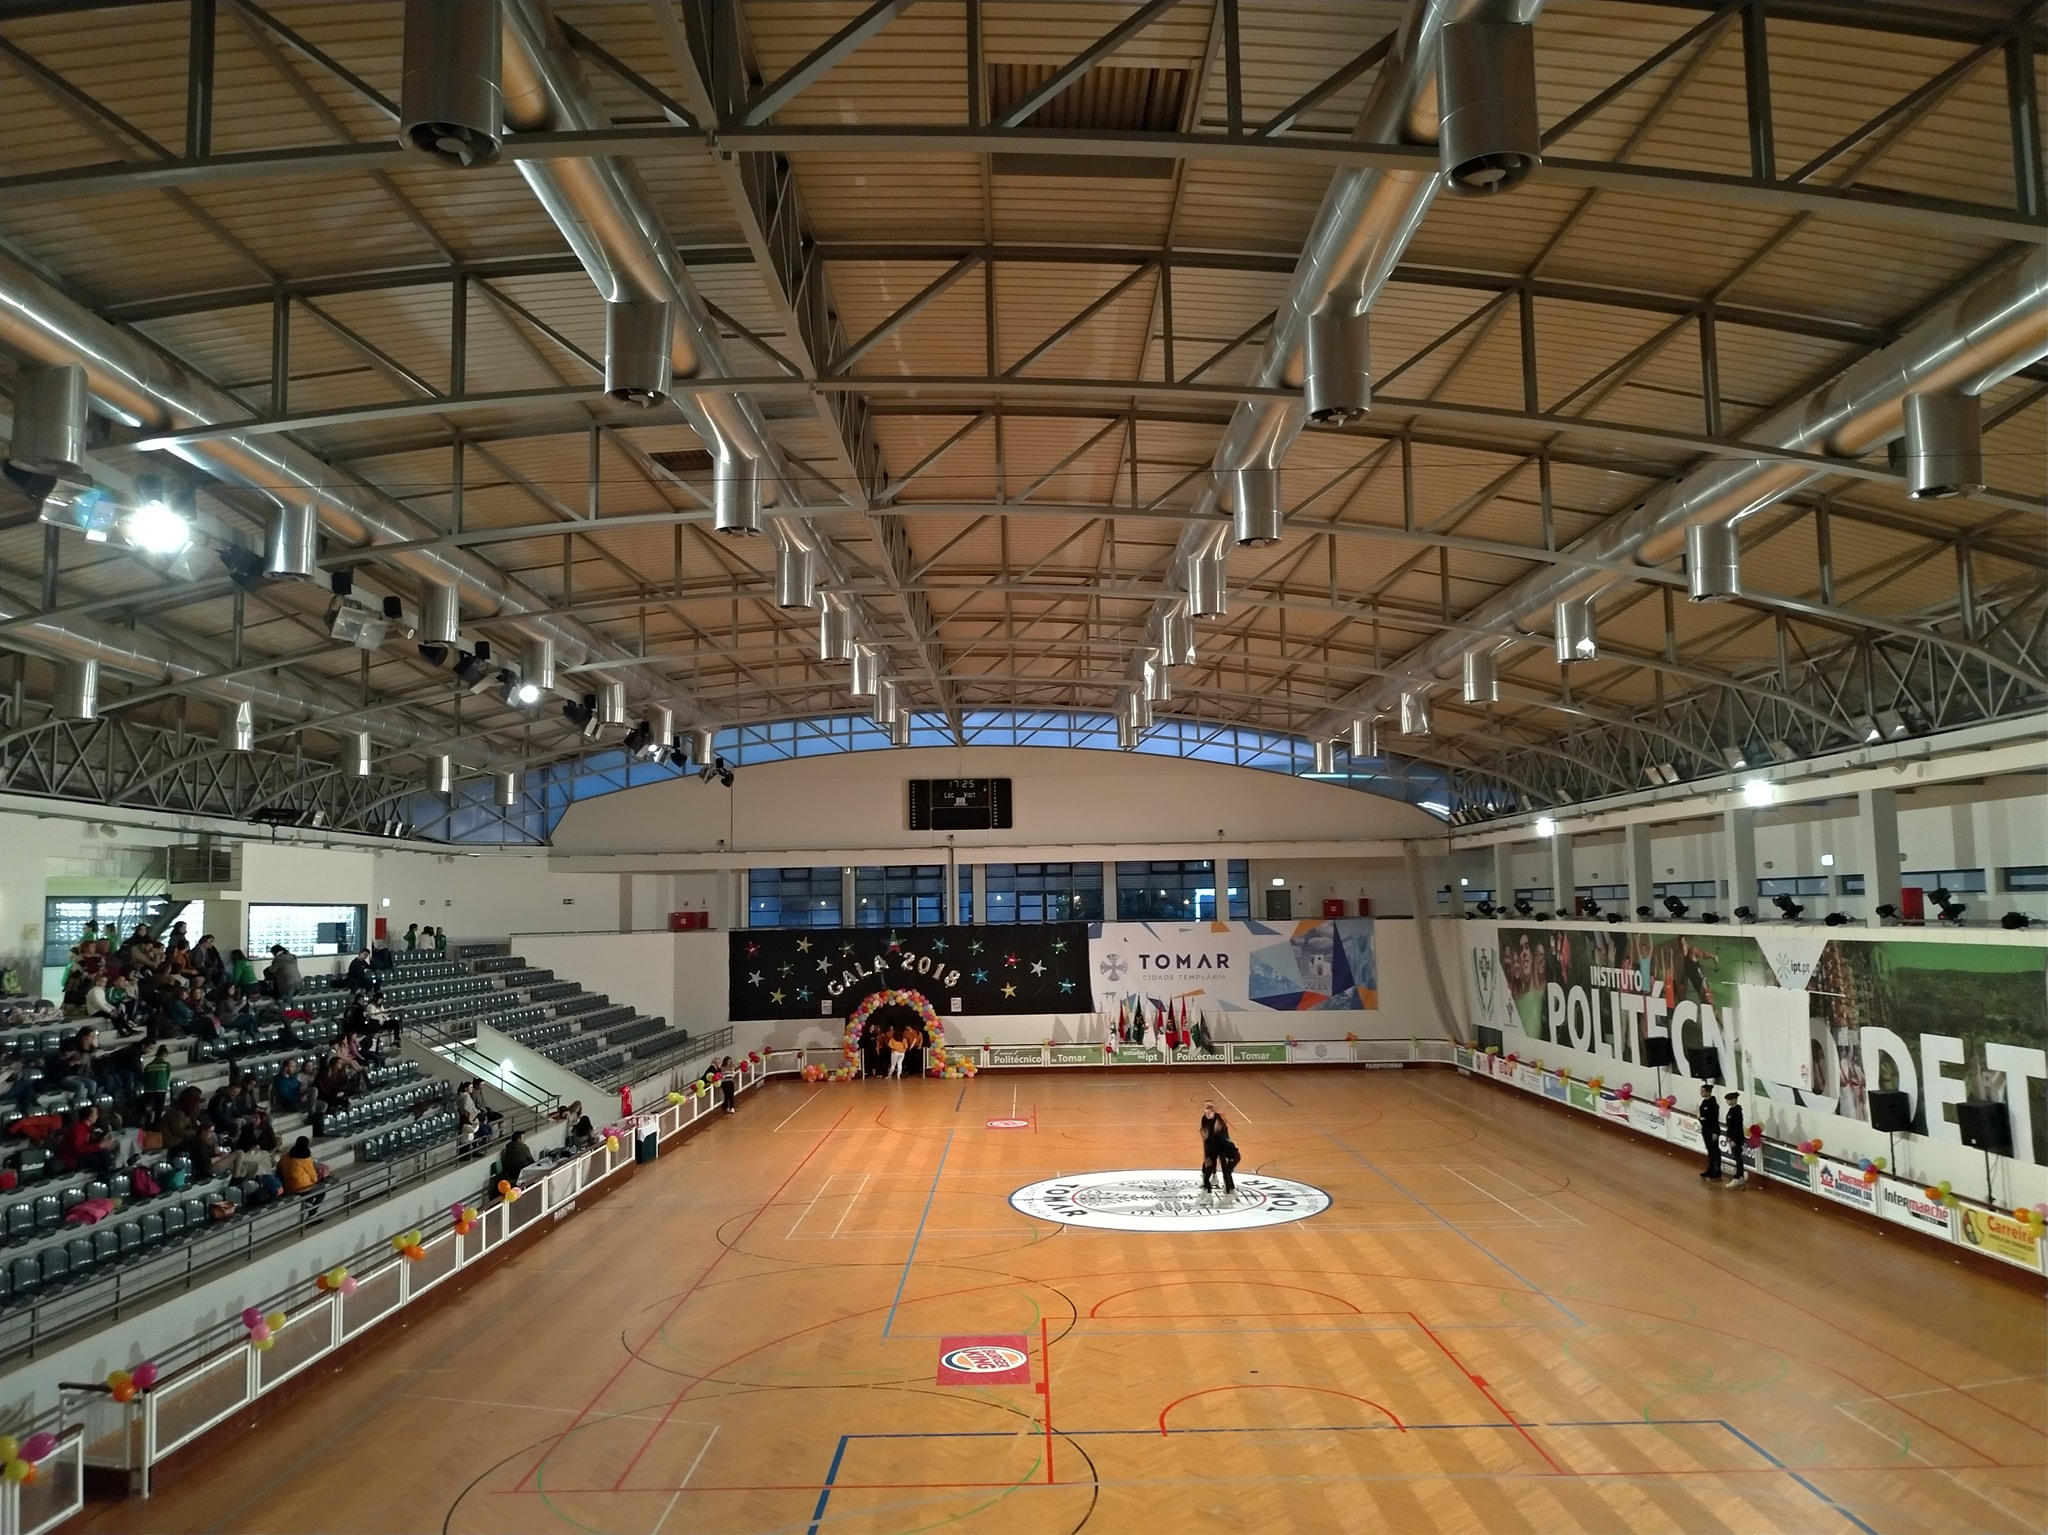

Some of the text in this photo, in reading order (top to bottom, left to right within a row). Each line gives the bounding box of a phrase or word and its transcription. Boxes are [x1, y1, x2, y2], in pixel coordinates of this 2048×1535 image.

[1139, 953, 1230, 969] TOMAR
[827, 952, 961, 996] GALA 2018
[1589, 965, 1643, 992] INSTITUTO
[994, 1053, 1042, 1064] Politécnico
[1057, 1054, 1087, 1063] Tomar
[1240, 1051, 1270, 1060] Tomar
[961, 1350, 997, 1369] KING
